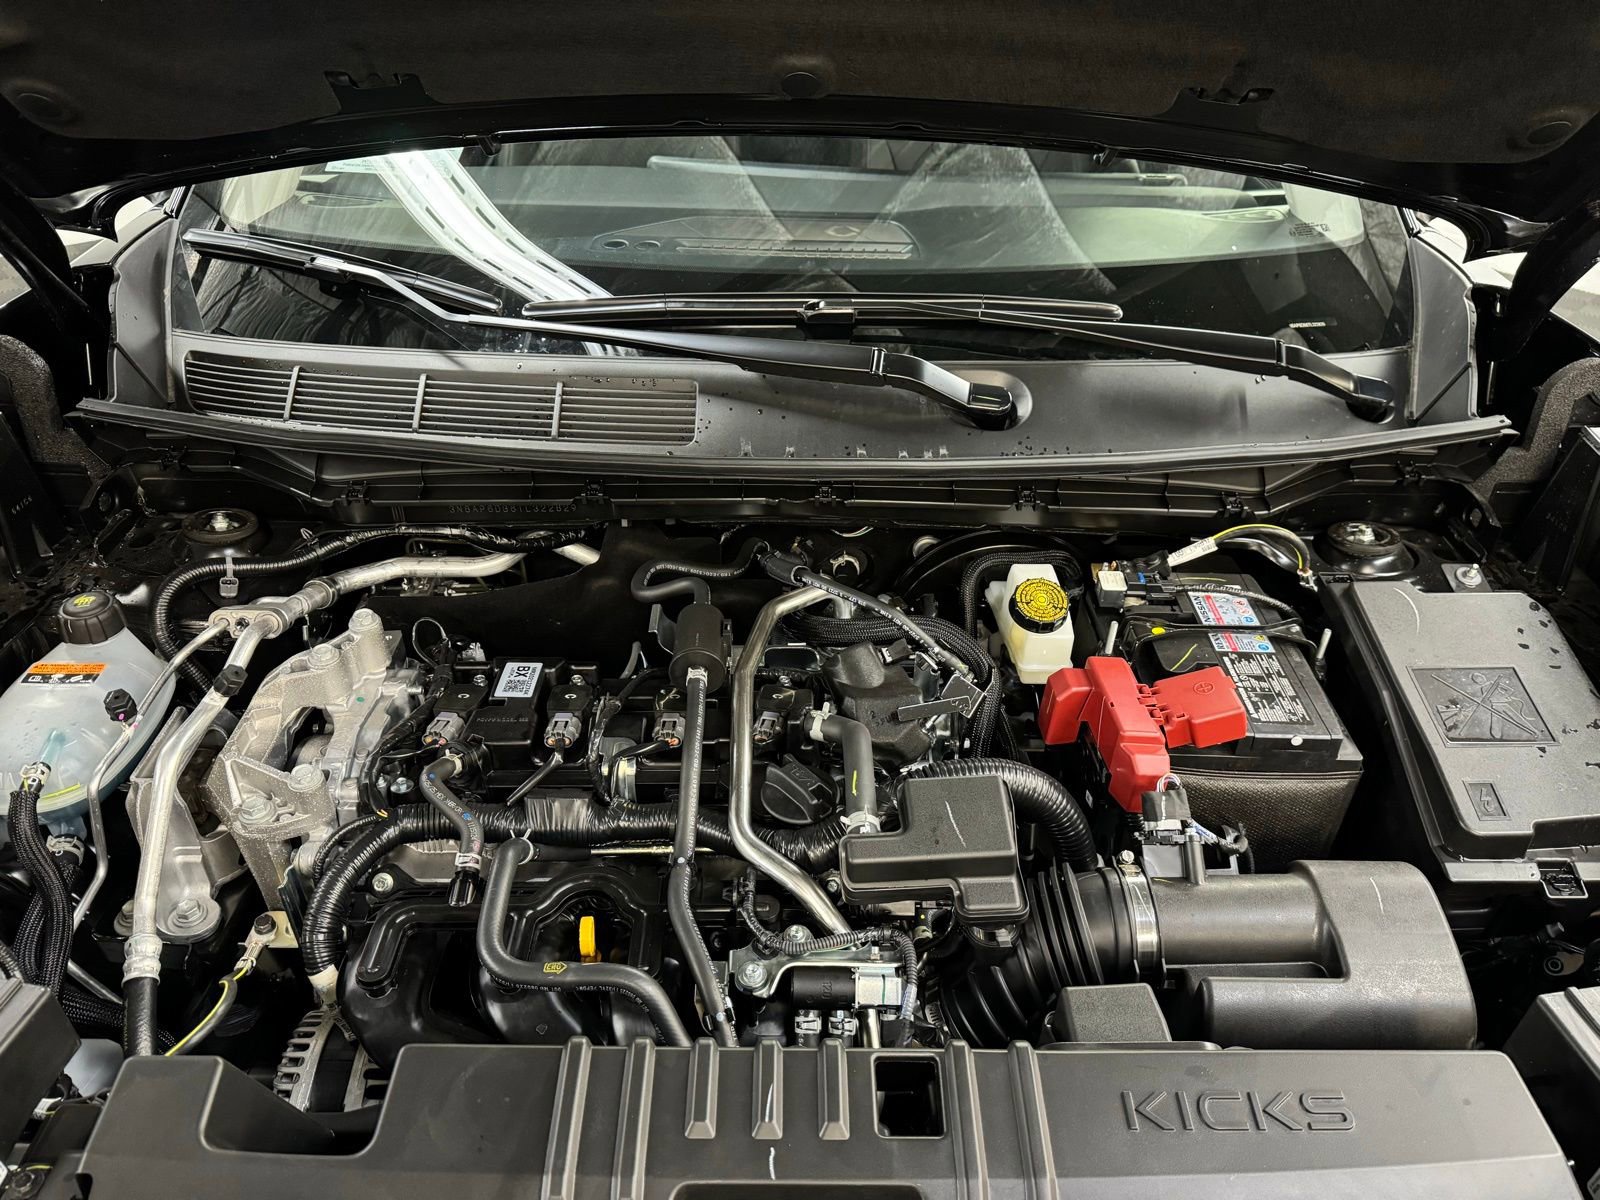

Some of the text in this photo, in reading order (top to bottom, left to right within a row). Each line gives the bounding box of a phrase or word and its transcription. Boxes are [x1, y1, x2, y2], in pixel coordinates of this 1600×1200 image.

[1193, 595, 1213, 623] NISSAN
[514, 666, 531, 678] BX
[1120, 1090, 1356, 1132] KICKS
